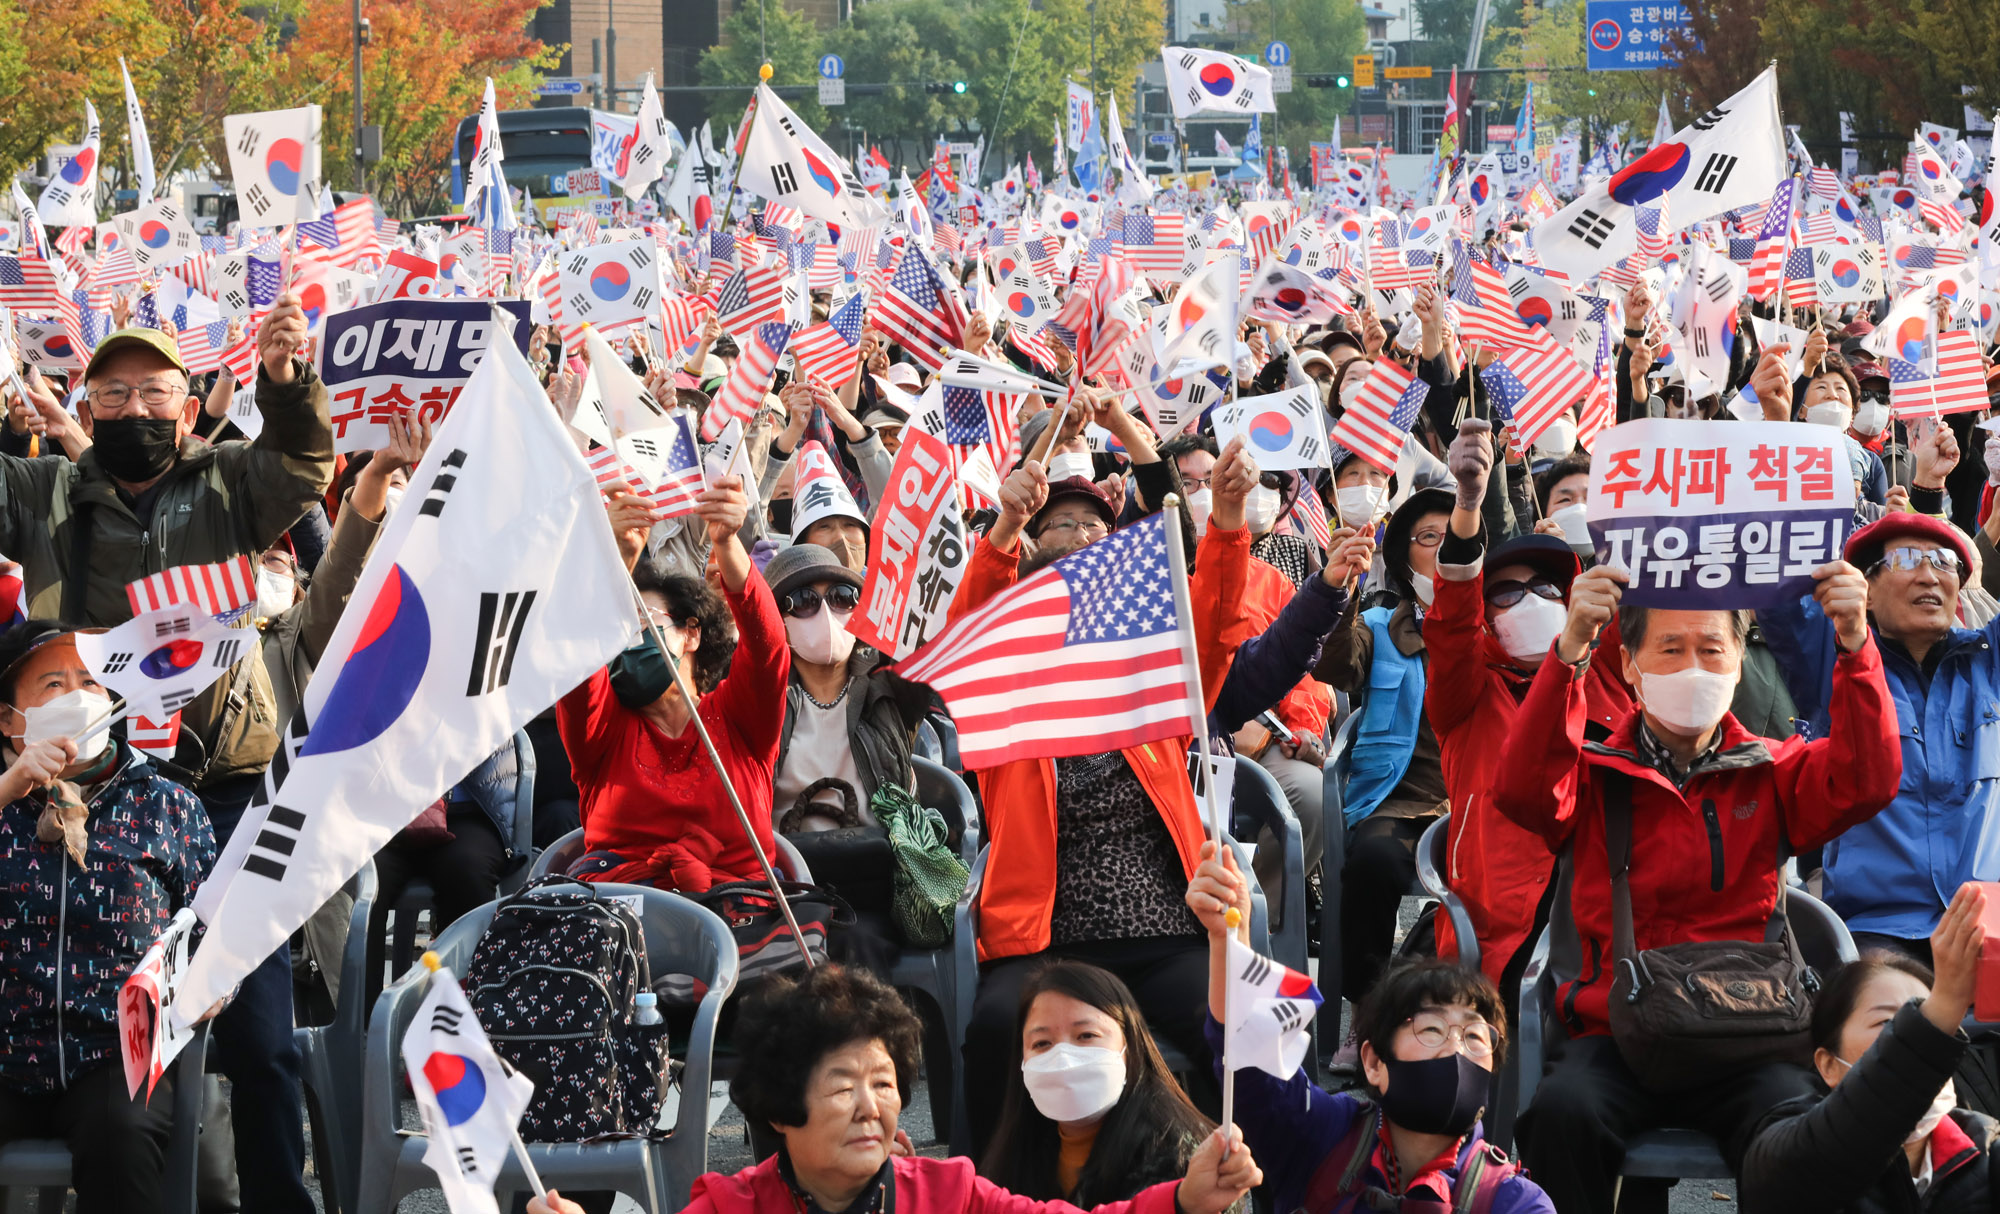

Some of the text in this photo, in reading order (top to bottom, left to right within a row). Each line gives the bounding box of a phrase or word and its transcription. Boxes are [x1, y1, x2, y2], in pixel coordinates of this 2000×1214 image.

[1629, 5, 1693, 23] 관광버스
[1520, 155, 1530, 169] 9
[1600, 443, 1834, 509] 주사파 척결
[866, 440, 951, 643] 문재인
[1604, 518, 1843, 589] 자유통일로!
